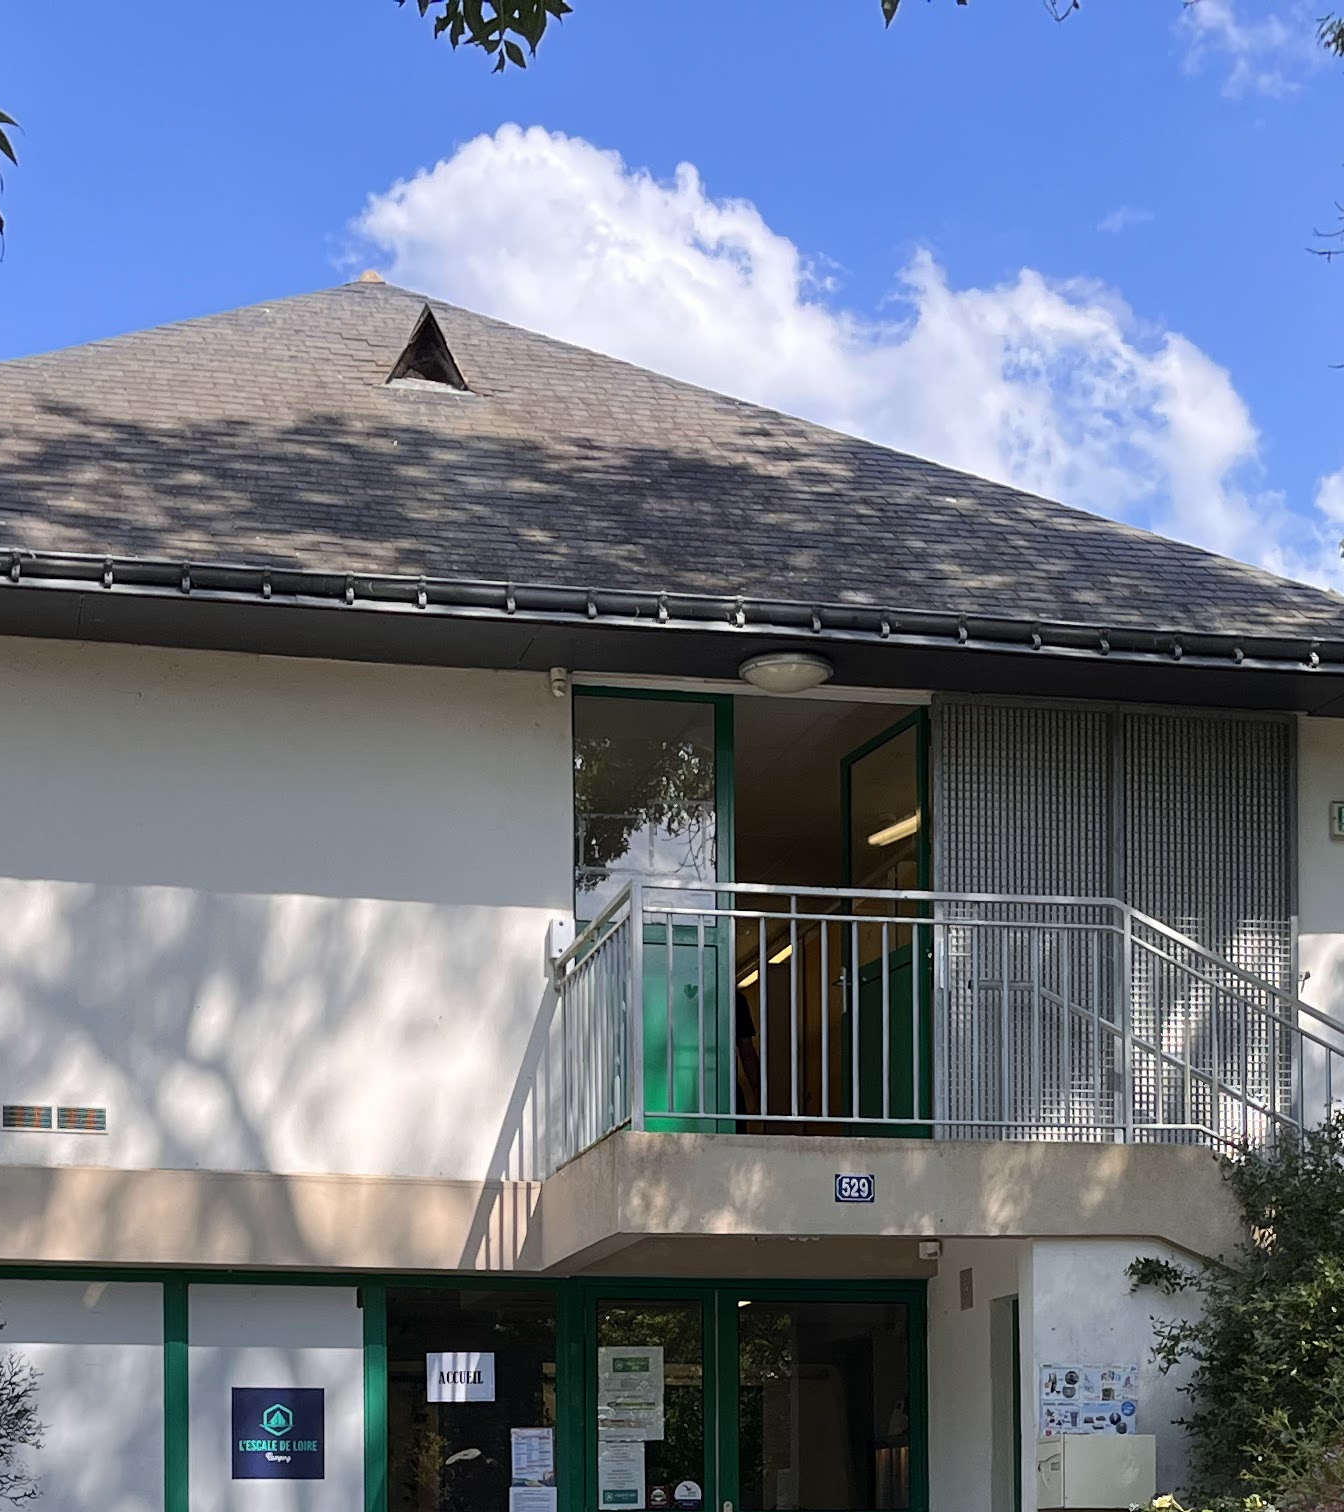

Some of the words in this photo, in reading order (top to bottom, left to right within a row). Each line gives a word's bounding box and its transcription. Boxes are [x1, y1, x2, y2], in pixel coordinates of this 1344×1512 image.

[841, 1178, 869, 1198] 529
[438, 1370, 484, 1385] ACCUEIL
[239, 1440, 277, 1452] L'ESCALE
[279, 1440, 292, 1452] DE
[293, 1440, 318, 1452] LOIRE
